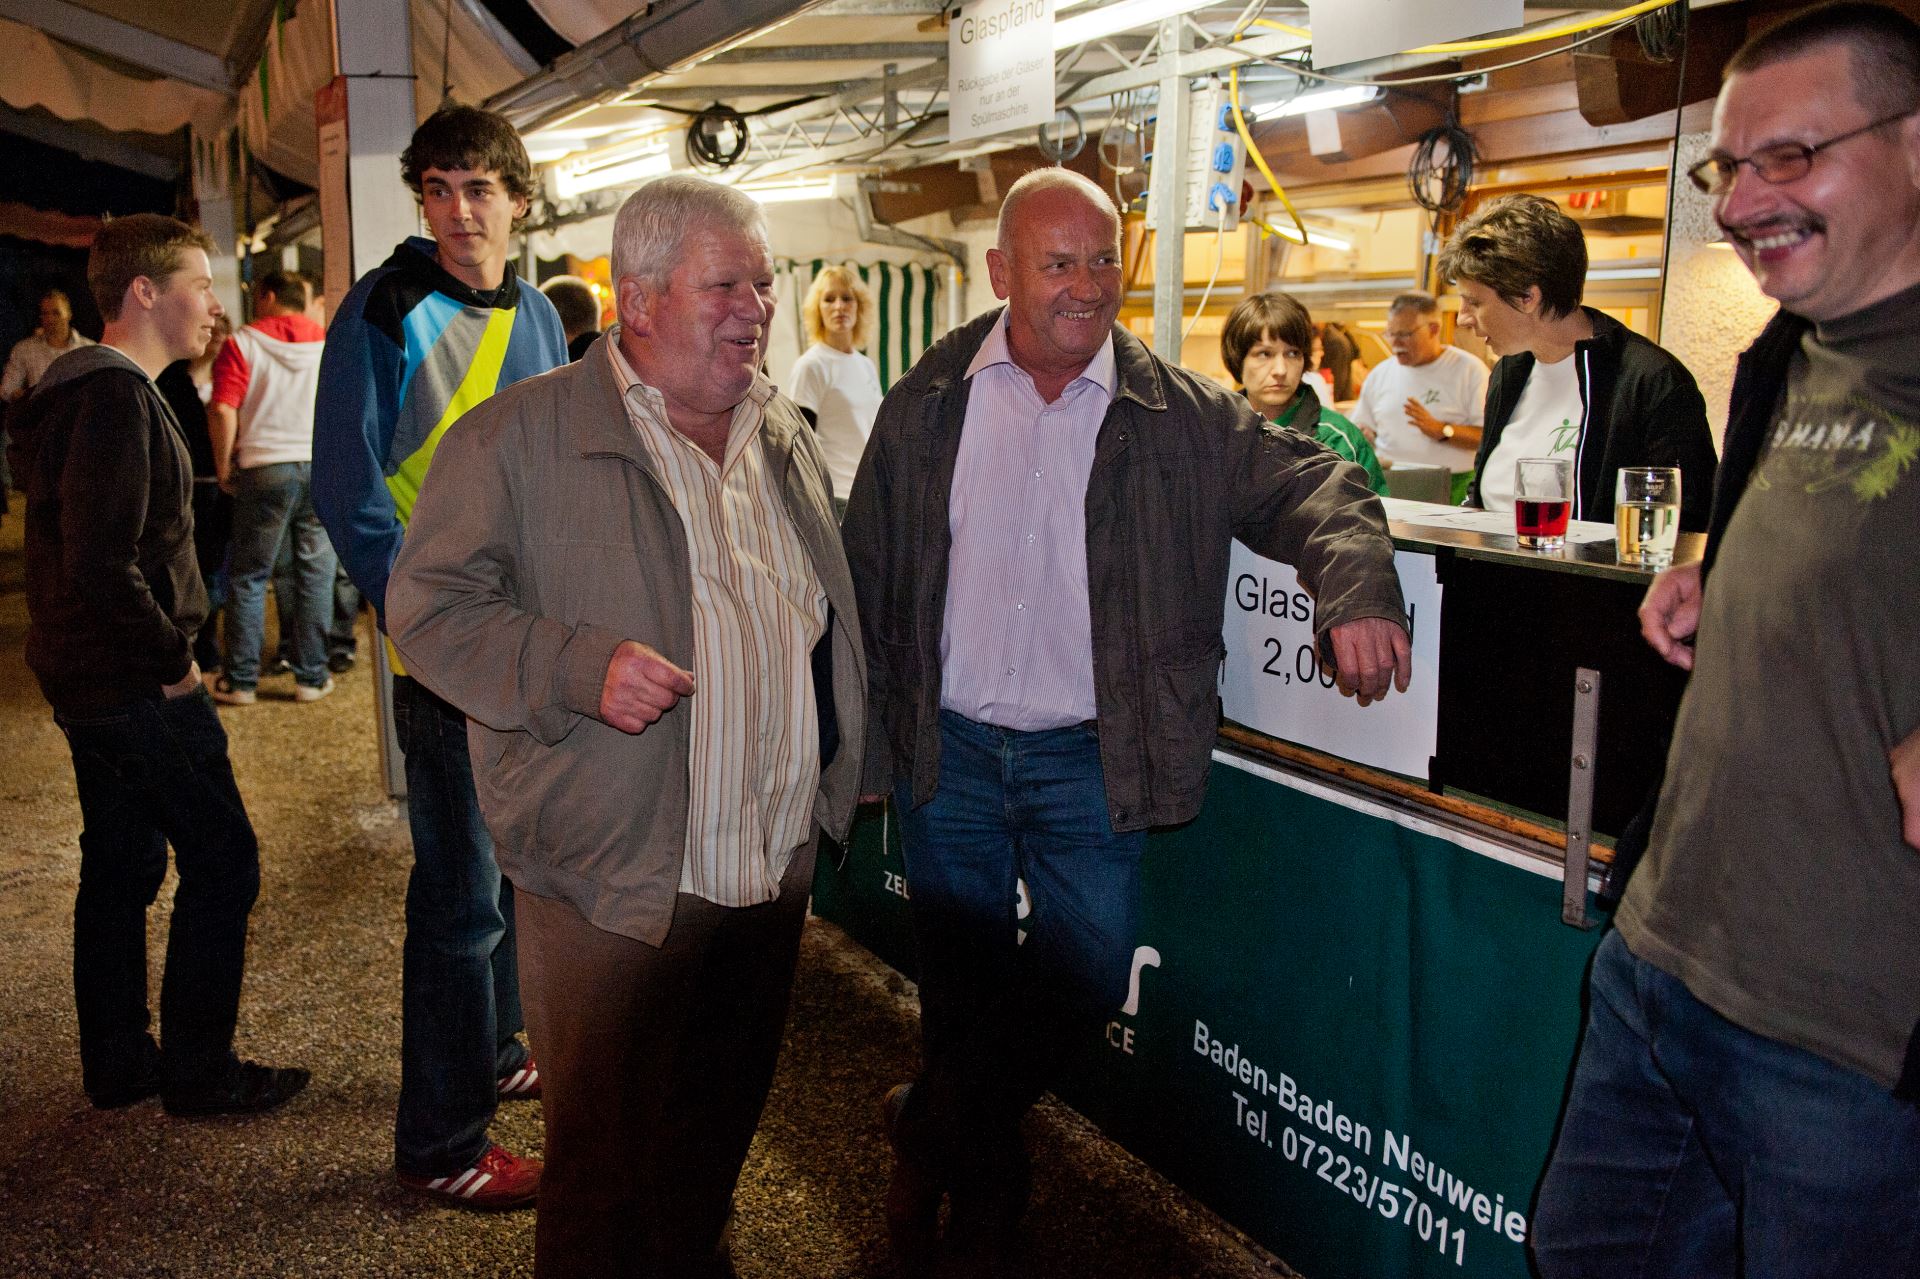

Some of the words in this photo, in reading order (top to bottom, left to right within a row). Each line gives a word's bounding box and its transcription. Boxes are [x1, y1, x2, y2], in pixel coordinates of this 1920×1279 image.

[960, 0, 1044, 44] Glaspfand
[1193, 1019, 1372, 1155] Baden-Baden
[1383, 1129, 1528, 1243] Neuweie
[1232, 1091, 1273, 1149] Tel.
[1282, 1126, 1465, 1266] 07223/57011
